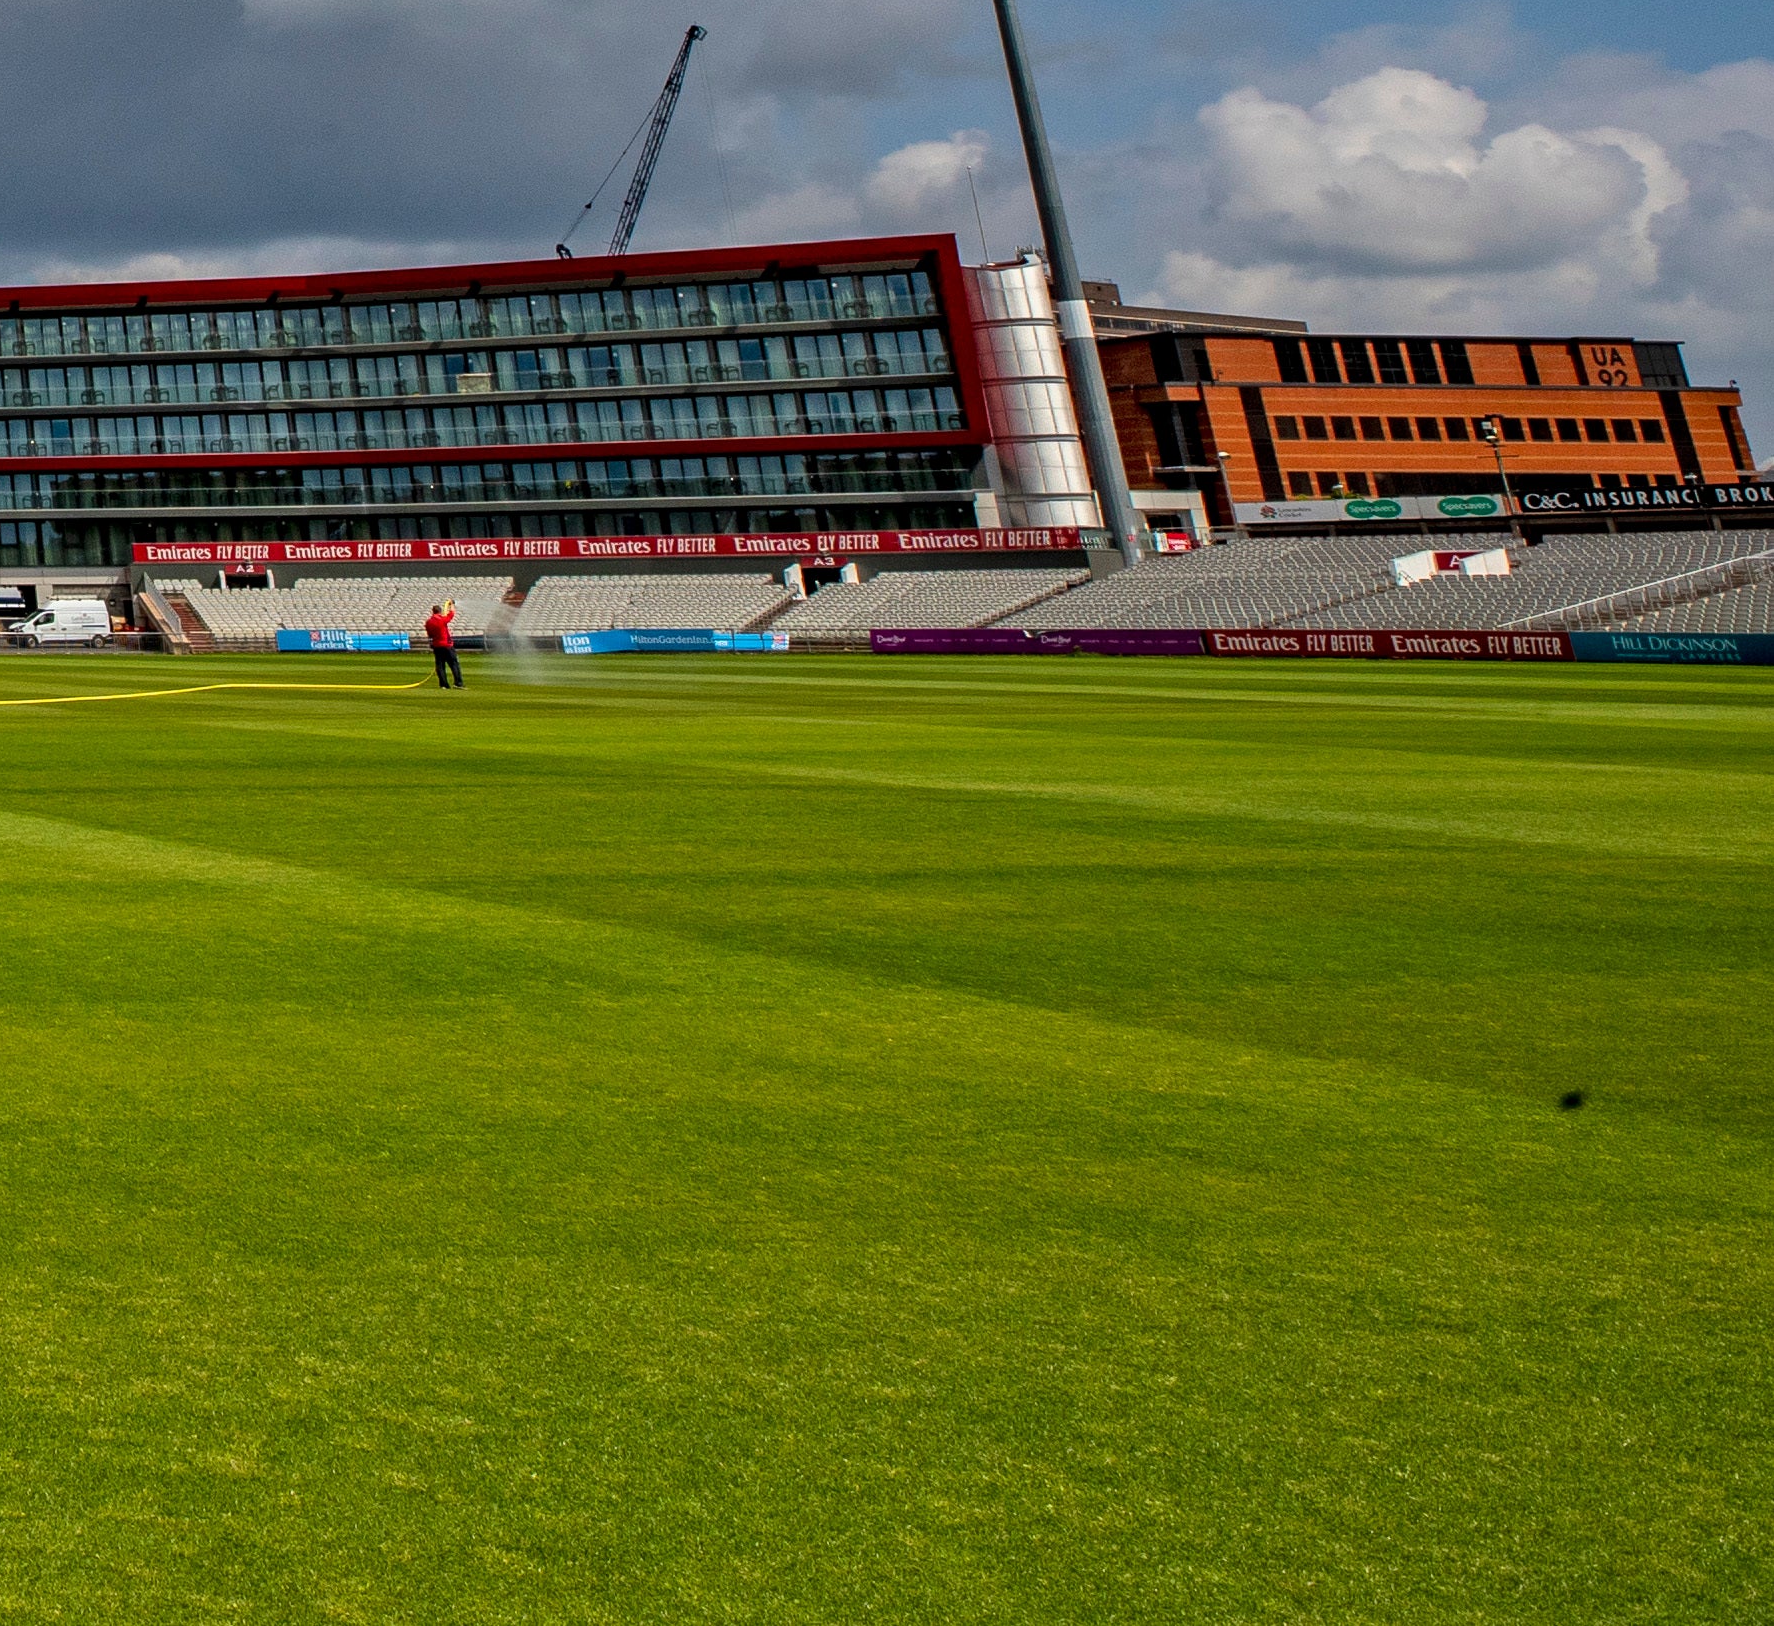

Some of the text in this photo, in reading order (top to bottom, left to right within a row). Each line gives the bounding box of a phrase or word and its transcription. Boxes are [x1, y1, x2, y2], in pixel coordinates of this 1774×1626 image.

[1591, 347, 1626, 366] UA
[1598, 369, 1628, 386] 92
[1715, 485, 1774, 503] BROK
[1349, 505, 1397, 514] Specsavers
[1443, 502, 1491, 511] Specsavers
[577, 538, 716, 555] Emirates FLY BETTER
[734, 534, 879, 552] Emirates FLY BETTER
[897, 533, 979, 549] Emirates
[985, 531, 1004, 547] FLY
[1008, 530, 1051, 547] BETTER
[146, 545, 269, 560] Emirates FLY BETTER
[284, 543, 412, 559] Emirates FLY BETTER
[428, 541, 560, 557] Emirates FLY BETTER
[236, 564, 254, 573] A2
[814, 557, 835, 566] A3
[1213, 633, 1374, 653] Emirates FLY BETTER
[1391, 634, 1562, 655] Emirates FLY BETTER
[1648, 636, 1738, 652] DICKINSON
[1680, 652, 1742, 661] LAWYERS
